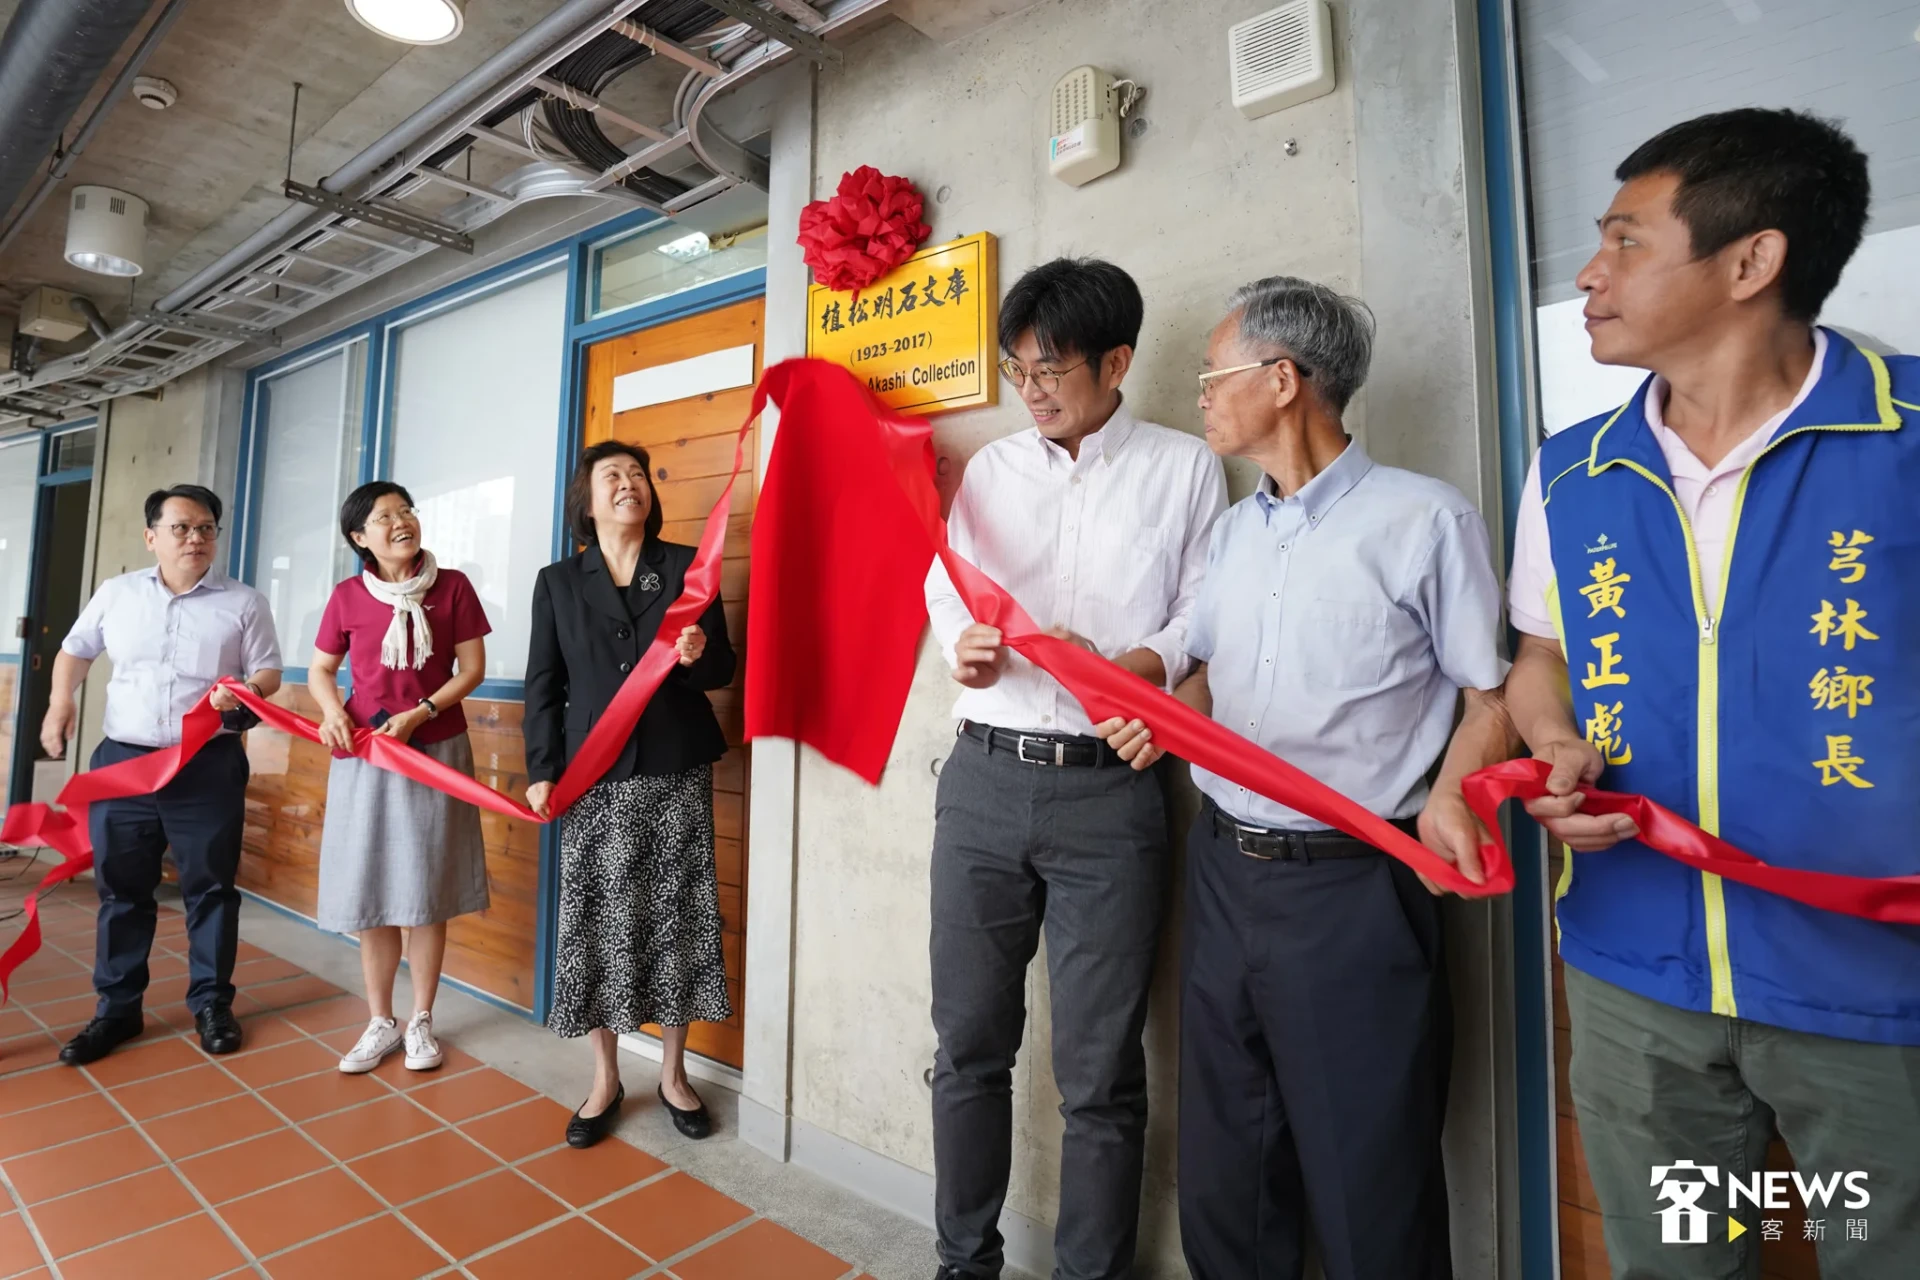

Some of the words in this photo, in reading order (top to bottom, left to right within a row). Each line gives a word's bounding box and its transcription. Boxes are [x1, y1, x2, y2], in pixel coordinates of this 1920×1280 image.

[820, 267, 969, 335] 植松明石文庫
[849, 331, 933, 367] (1923-2017)
[868, 370, 906, 393] Akashi
[912, 359, 975, 386] Collection
[1808, 529, 1880, 789] 芎林鄉長
